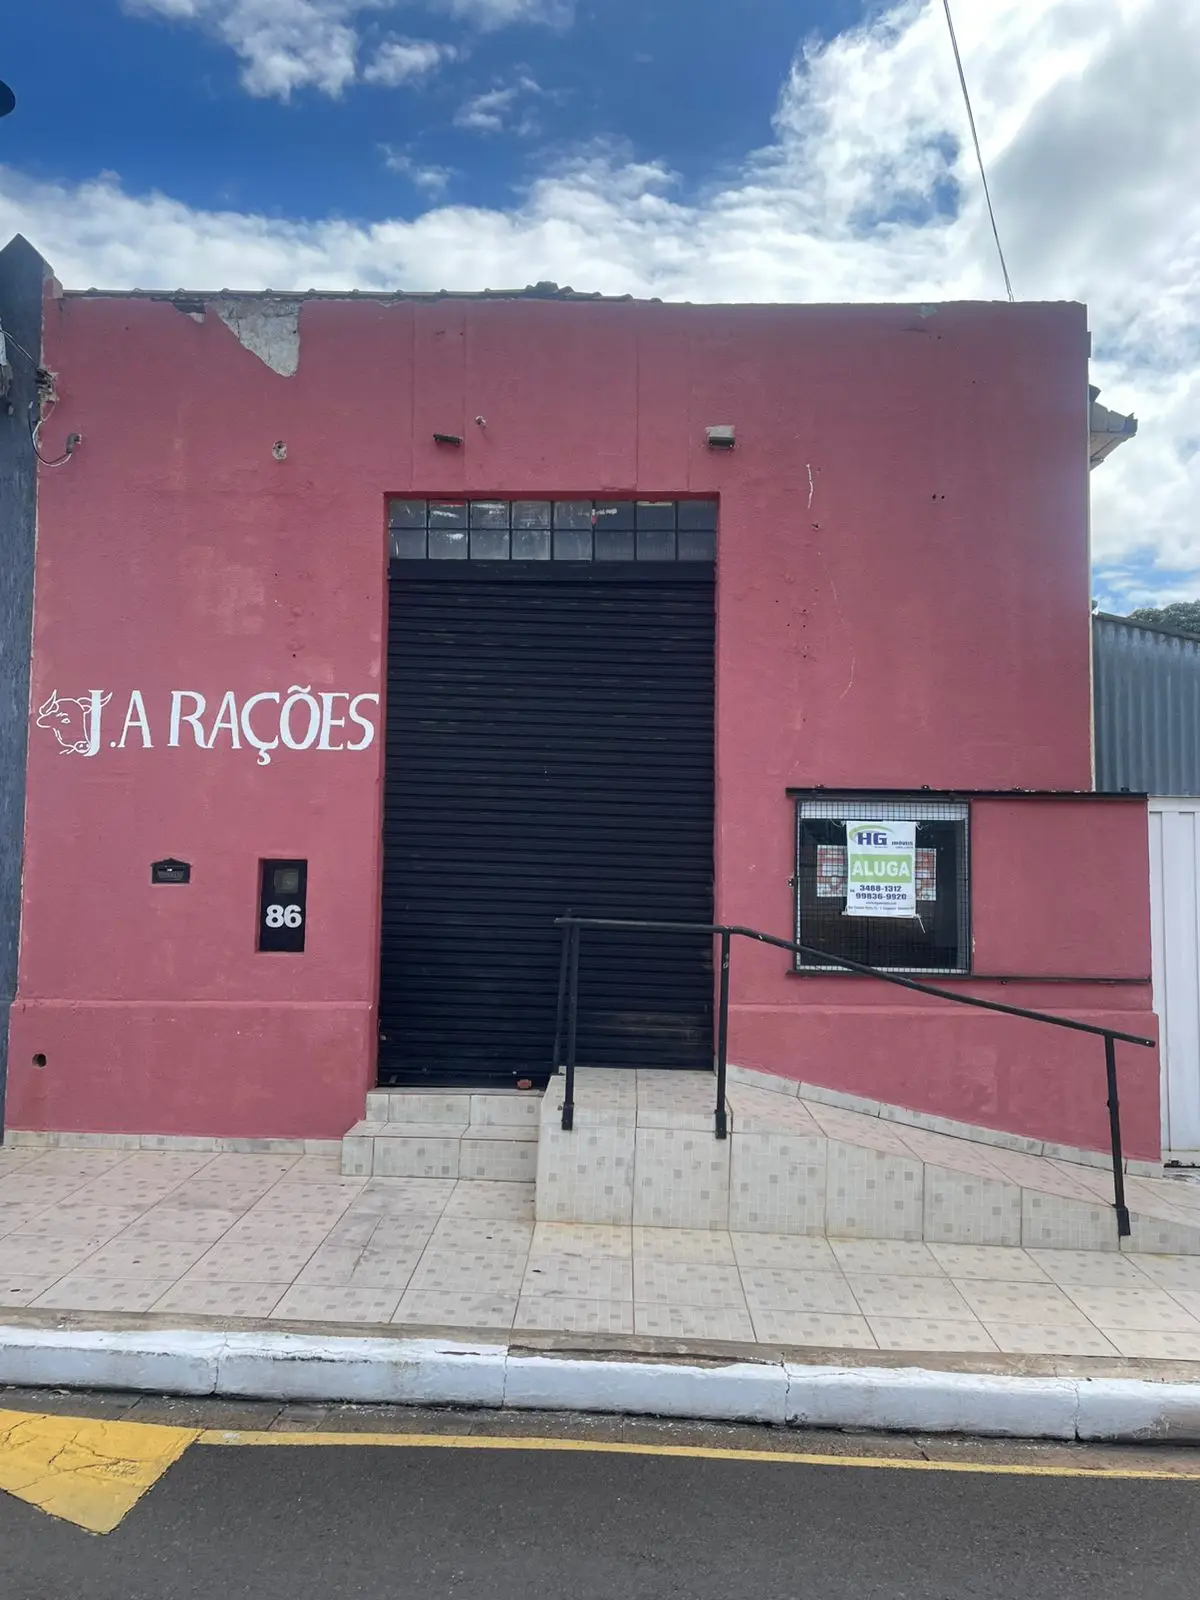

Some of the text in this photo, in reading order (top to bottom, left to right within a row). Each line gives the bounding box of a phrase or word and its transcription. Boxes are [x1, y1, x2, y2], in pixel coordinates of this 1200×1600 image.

[85, 685, 380, 766] J.A RAÇÕES
[857, 832, 887, 846] HG
[852, 861, 910, 877] ALUGA
[859, 884, 902, 892] 3488-1312
[265, 904, 303, 928] 86
